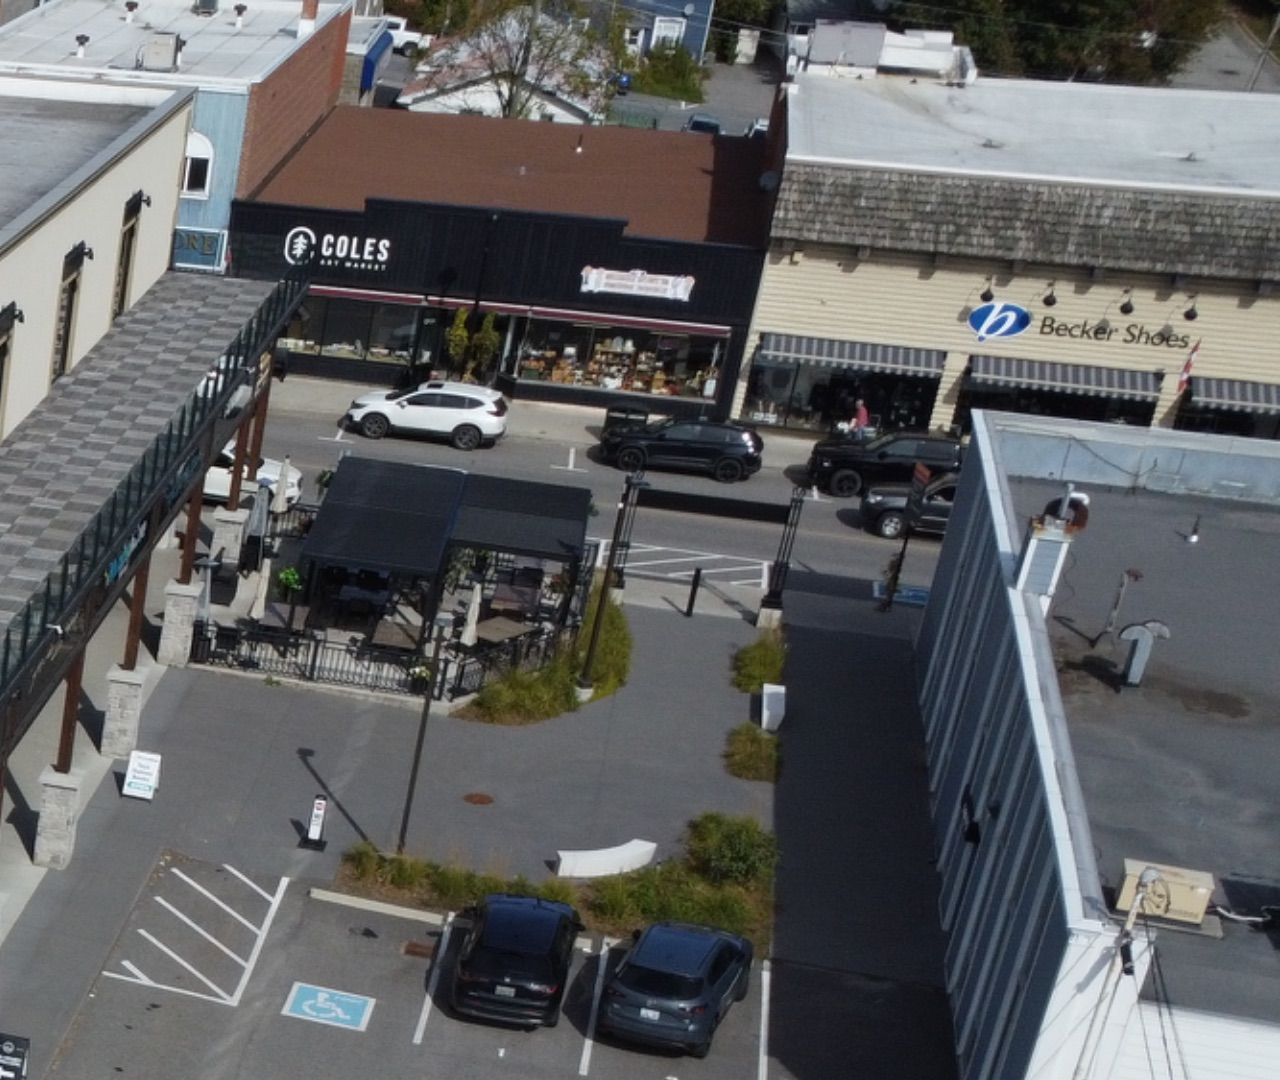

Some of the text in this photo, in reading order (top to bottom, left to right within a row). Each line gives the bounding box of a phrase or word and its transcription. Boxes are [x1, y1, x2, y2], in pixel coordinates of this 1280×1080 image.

[321, 233, 391, 262] COLES
[344, 261, 387, 272] MARKET
[1039, 315, 1191, 349] Becker Shoes
